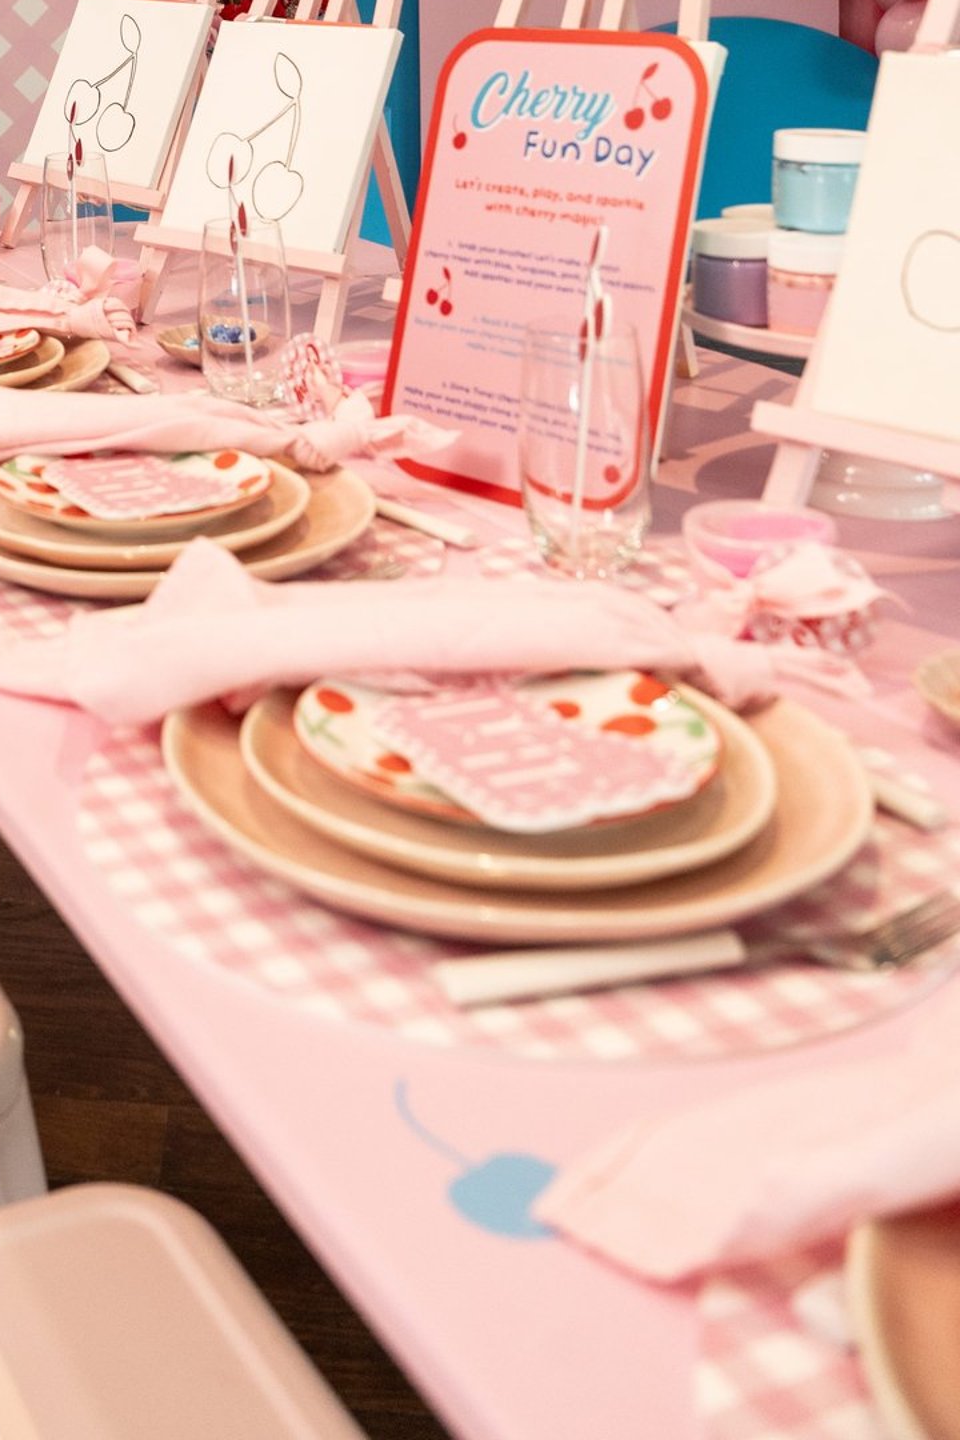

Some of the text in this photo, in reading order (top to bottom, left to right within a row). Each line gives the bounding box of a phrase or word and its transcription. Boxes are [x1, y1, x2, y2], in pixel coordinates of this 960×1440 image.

[471, 70, 614, 140] Cherry
[523, 131, 655, 176] Fun Day
[566, 191, 592, 204] and
